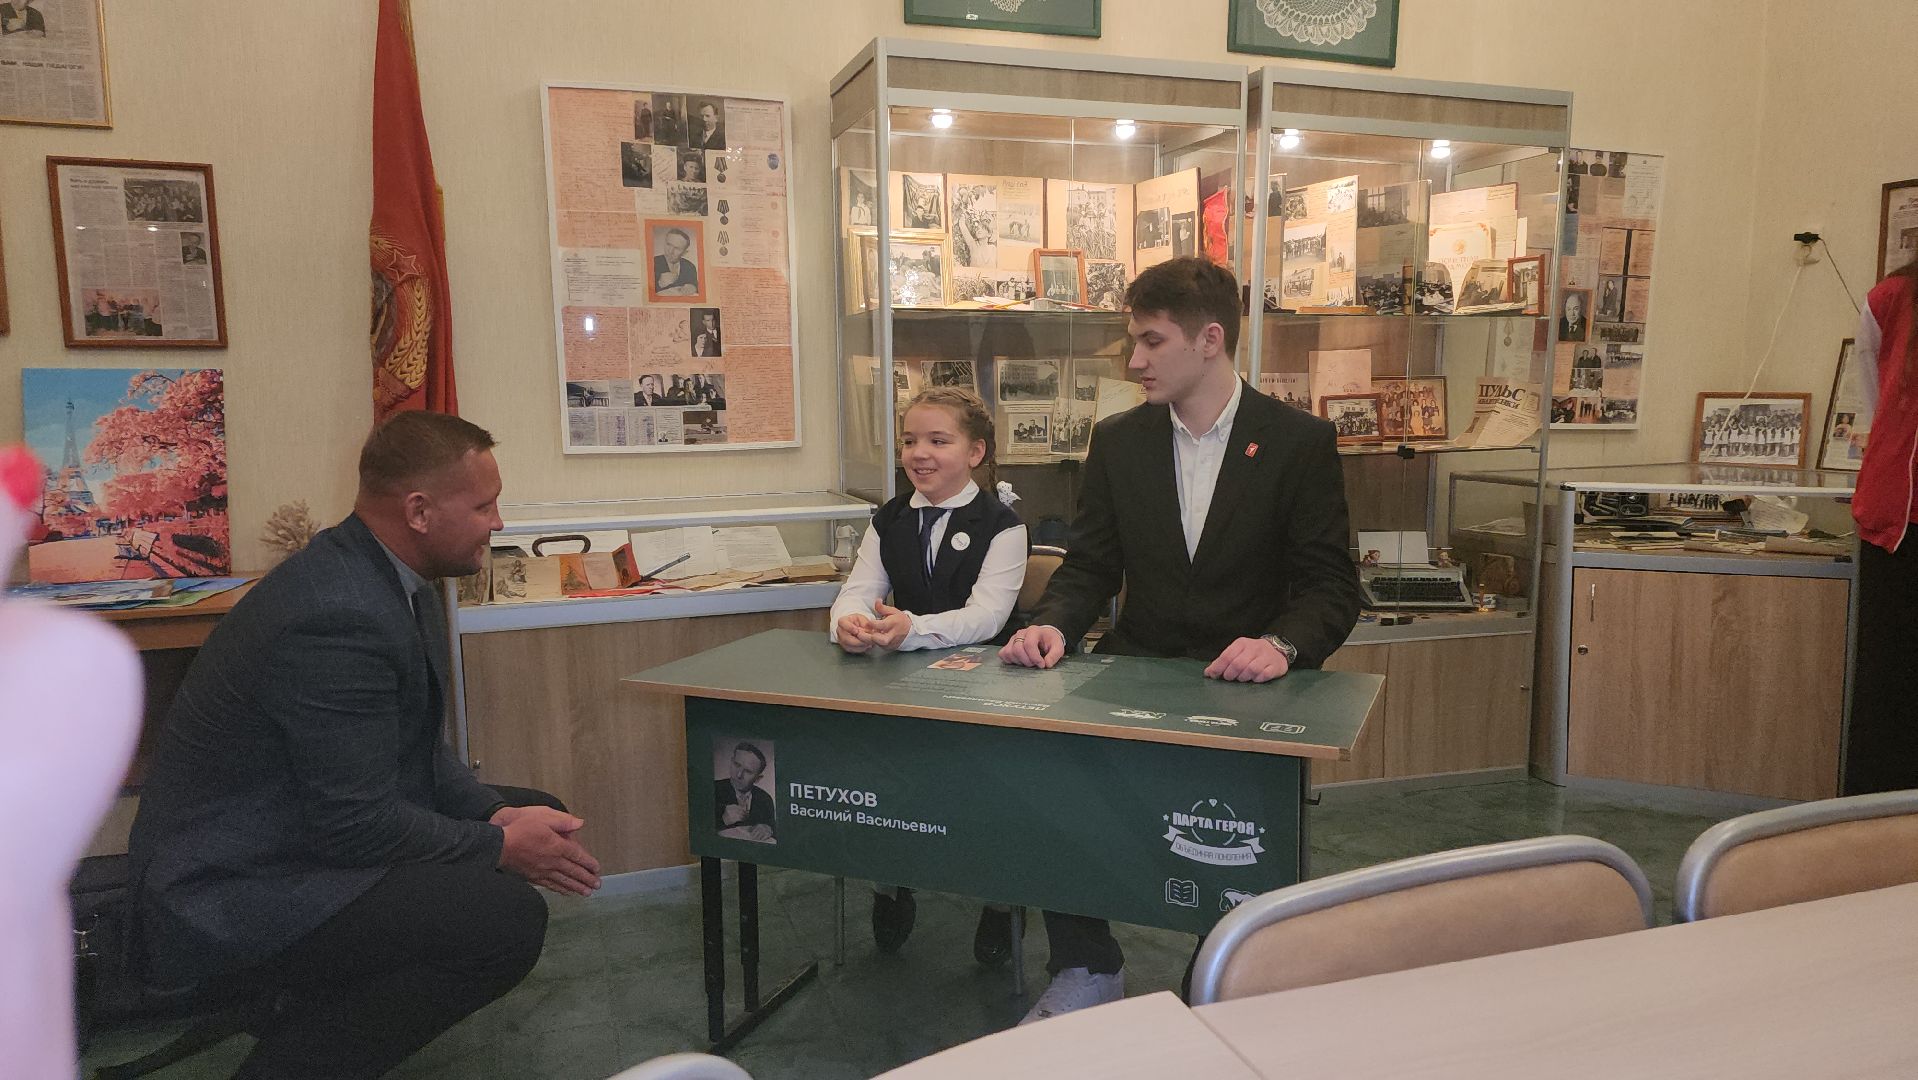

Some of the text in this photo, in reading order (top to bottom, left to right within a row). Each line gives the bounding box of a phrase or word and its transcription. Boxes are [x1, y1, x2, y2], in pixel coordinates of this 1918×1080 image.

[1478, 384, 1526, 402] ПУЛЬС
[789, 783, 878, 808] ПЕТУХОВ
[790, 803, 947, 835] Василий Васильевич
[1172, 811, 1255, 836] ПАРТА ГЕРОЯ
